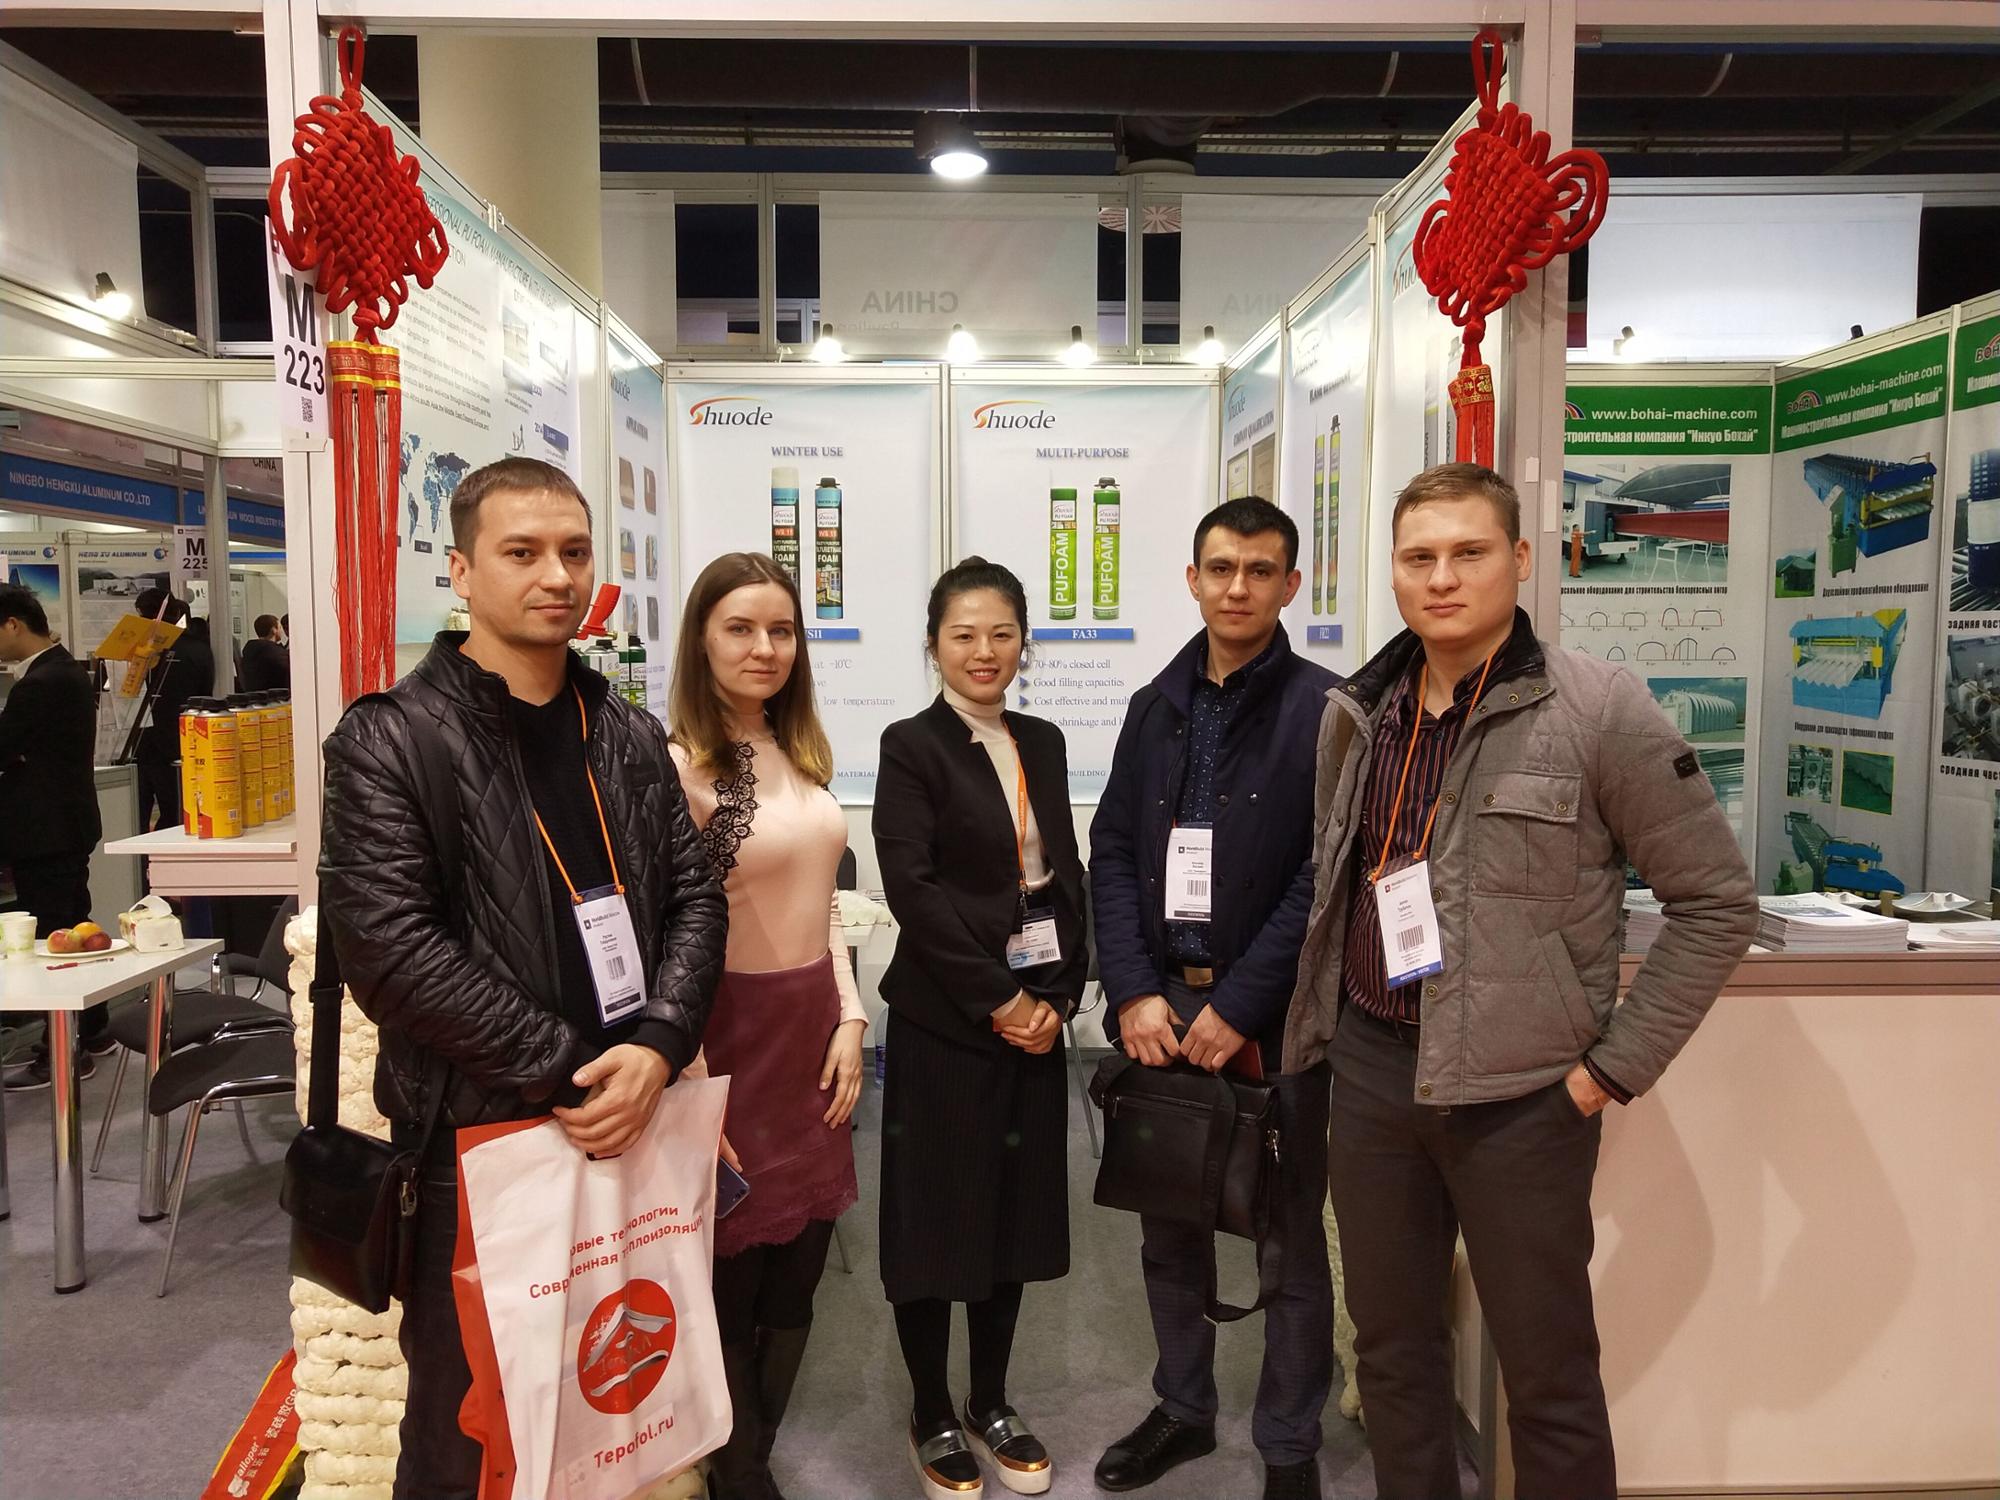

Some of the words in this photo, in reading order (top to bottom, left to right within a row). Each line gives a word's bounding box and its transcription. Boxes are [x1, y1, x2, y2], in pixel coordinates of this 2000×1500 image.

[285, 273, 316, 347] M
[284, 344, 325, 396] 223
[1825, 364, 1943, 405] www.bohai-machine.com
[689, 397, 773, 426] Shuode
[973, 400, 1056, 429] Shuode
[1591, 408, 1758, 421] www.bohai-machine.com
[1634, 431, 1686, 443] компания
[1687, 430, 1722, 444] "Инкуо
[1724, 428, 1759, 442] Бохай"
[771, 446, 818, 457] WINTER
[821, 446, 843, 457] USE
[1036, 448, 1129, 459] MULTI-PURPOSE
[252, 458, 277, 472] CHINA
[9, 471, 45, 488] NINGBO
[46, 478, 80, 494] HENGXU
[82, 484, 122, 502] ALUMINUM
[186, 538, 206, 556] M
[774, 554, 795, 562] FOAM
[1055, 532, 1069, 602] PUFOAM
[1100, 536, 1114, 603] PUFOAM
[1948, 620, 1980, 630] задняя
[1072, 629, 1097, 639] FA33
[1069, 659, 1095, 669] closed
[1096, 659, 1111, 669] cell
[1033, 678, 1056, 687] Good
[1059, 677, 1083, 689] filling
[1085, 677, 1125, 689] capacities
[824, 697, 838, 705] low
[843, 697, 895, 707] temperature
[1034, 696, 1053, 706] Cost
[1055, 695, 1090, 706] effective
[1092, 696, 1108, 706] and
[1058, 717, 1099, 729] shrinkage
[1101, 716, 1117, 727] and
[1068, 769, 1107, 777] BUILDING
[1940, 764, 1980, 778] средняя
[570, 1235, 604, 1257] овые
[610, 1206, 679, 1244] тенологии
[529, 1253, 619, 1299] Соврменная
[594, 1415, 675, 1469] Tepofol.ru
